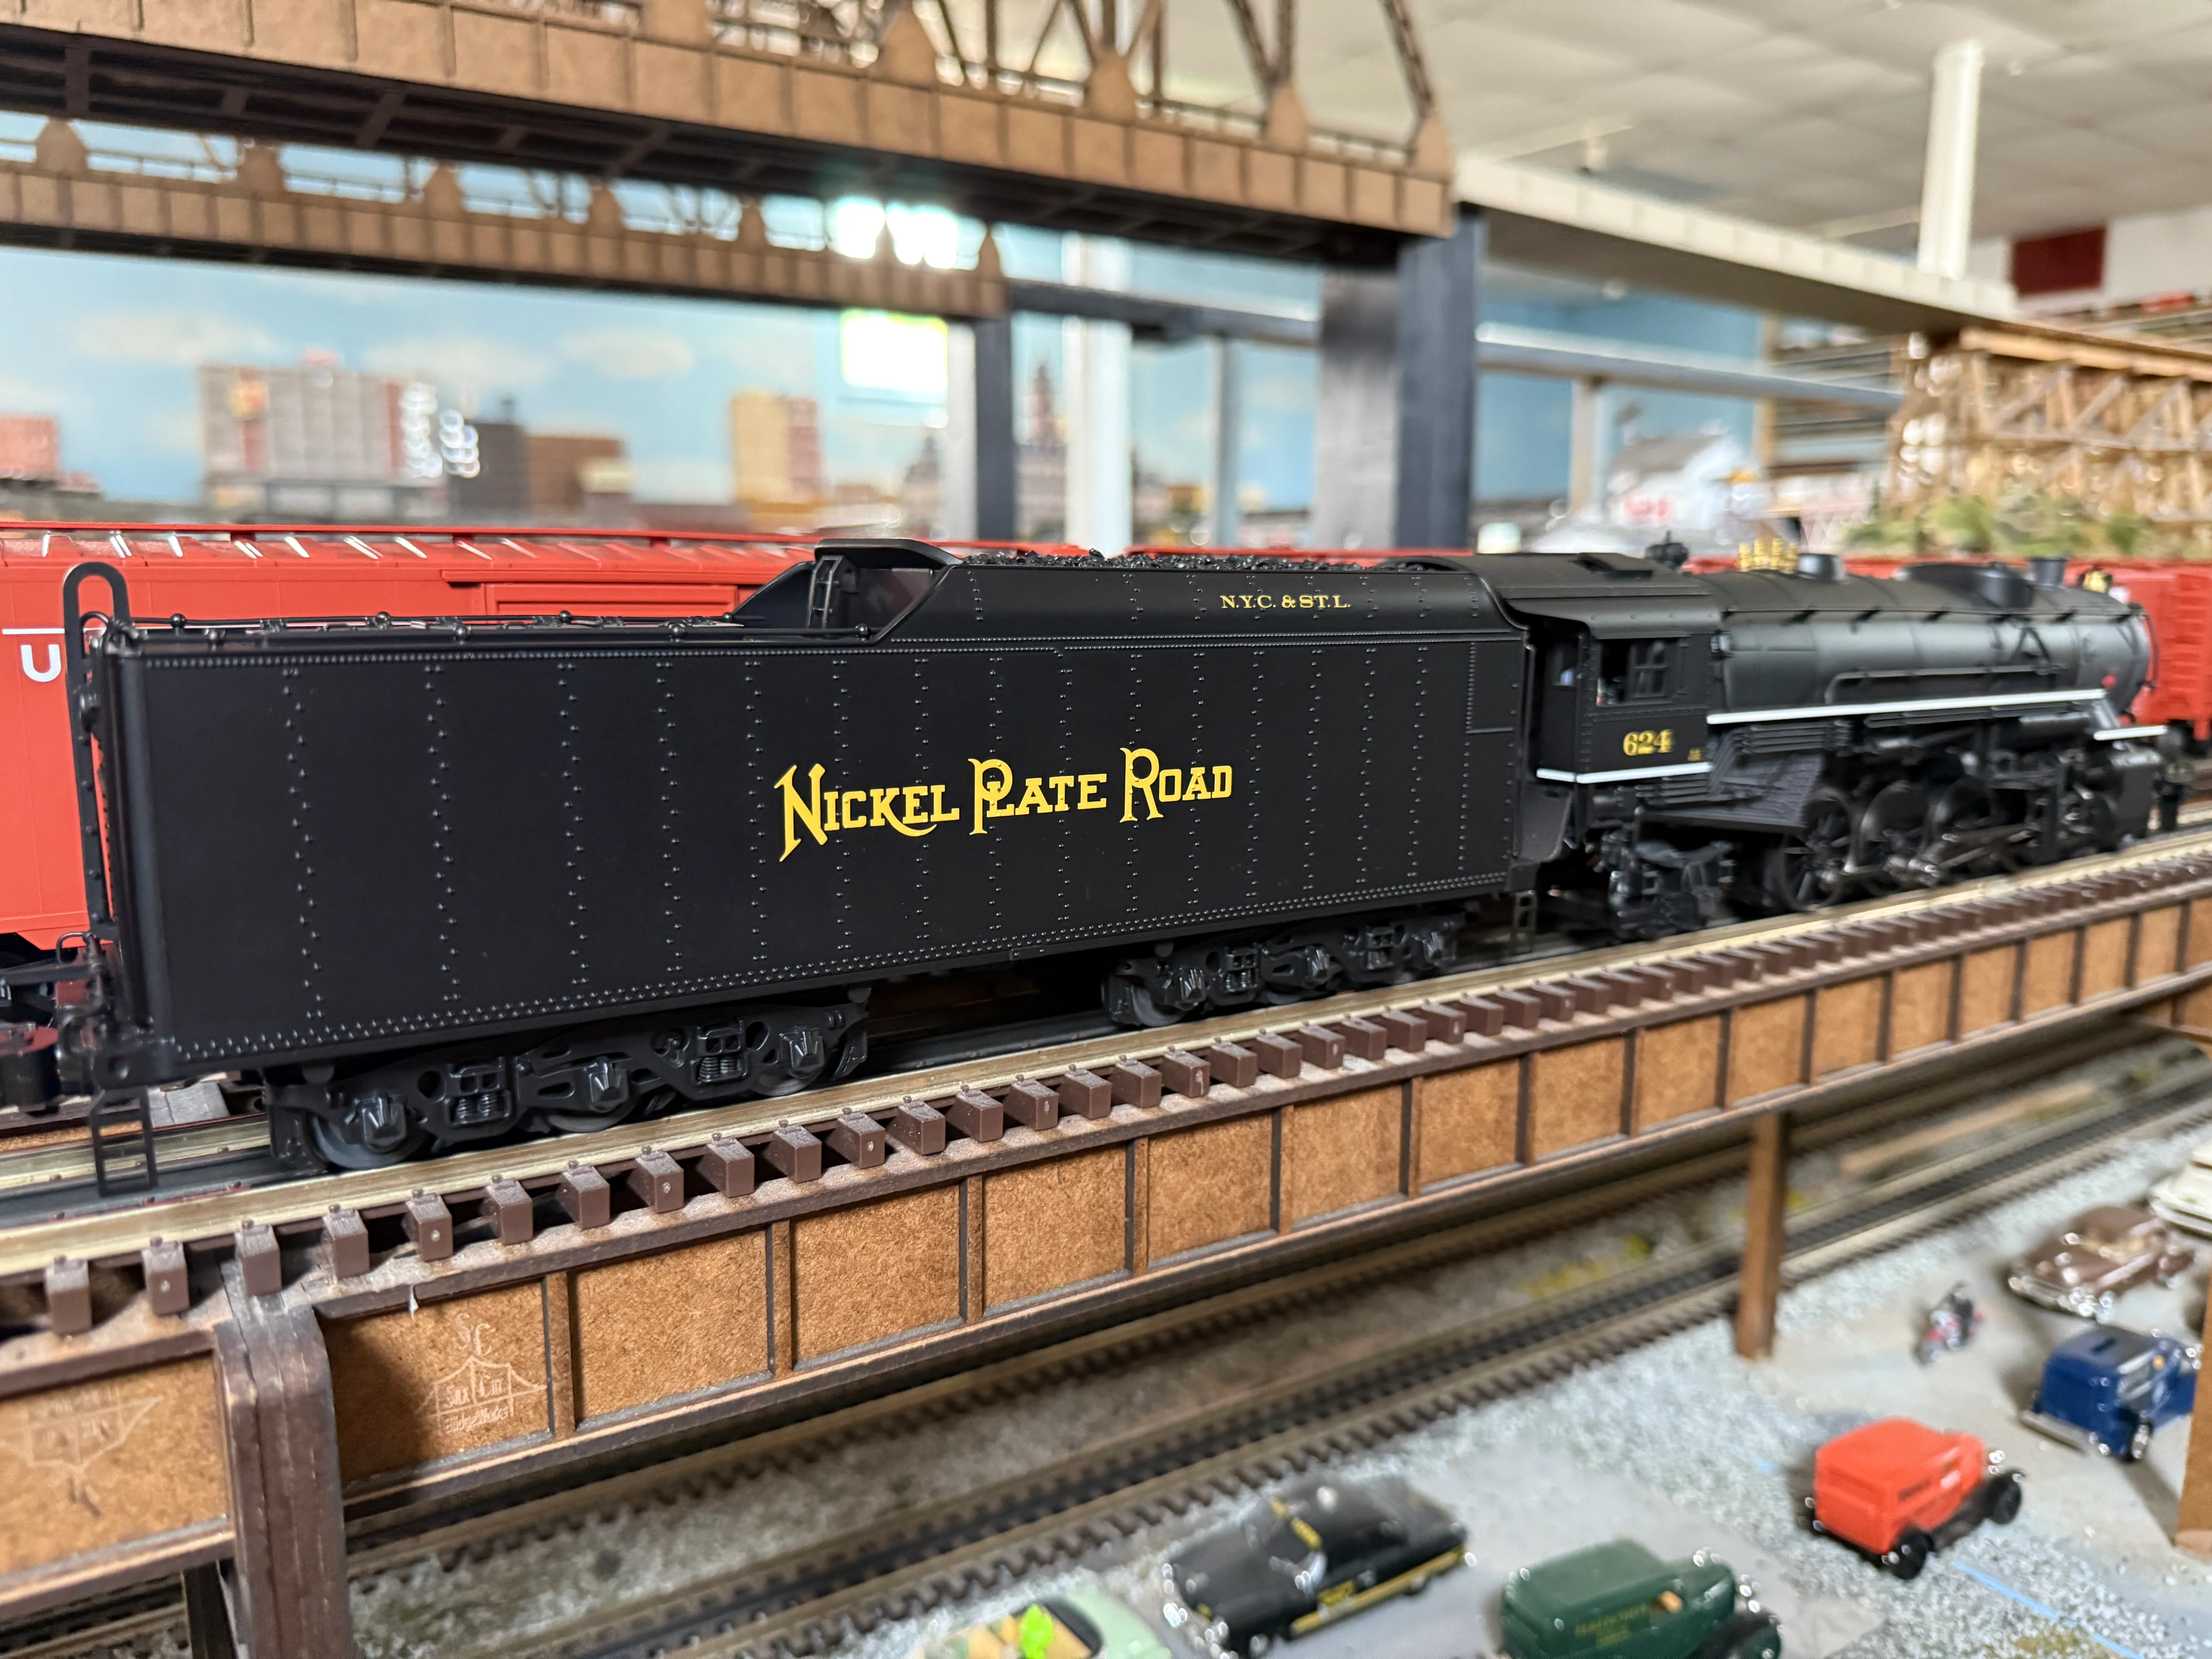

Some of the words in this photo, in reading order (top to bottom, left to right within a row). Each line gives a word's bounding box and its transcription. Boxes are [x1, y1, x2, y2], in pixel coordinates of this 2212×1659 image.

[1281, 595, 1297, 608] &
[1623, 728, 1674, 756] 624
[775, 763, 959, 862] NICKEL
[967, 758, 1108, 835] PLATE
[1119, 747, 1233, 823] ROAD
